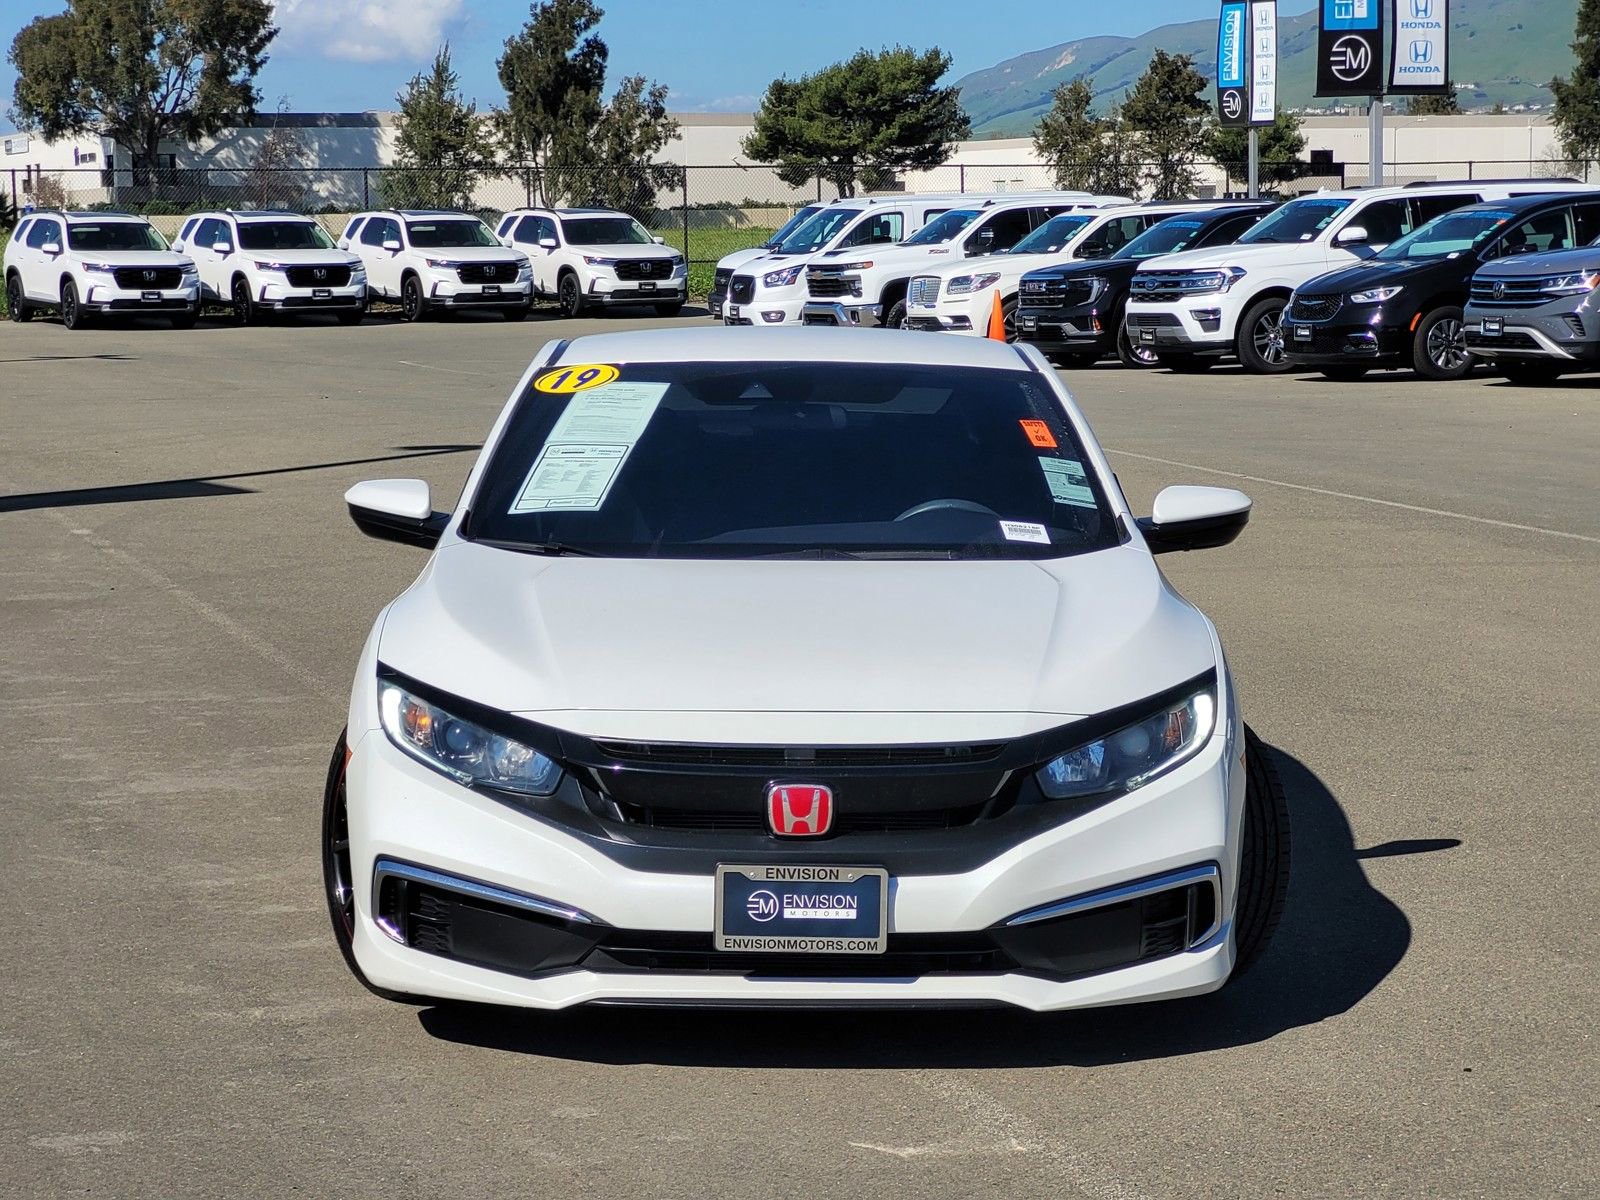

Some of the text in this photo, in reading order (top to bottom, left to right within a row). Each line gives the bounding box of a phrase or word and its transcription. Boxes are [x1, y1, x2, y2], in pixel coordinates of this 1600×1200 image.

[1223, 11, 1235, 80] ENVISION
[550, 368, 601, 390] 19
[765, 868, 839, 880] ENVISION
[783, 894, 857, 908] ENVISION
[724, 938, 878, 951] ENVISIONMOTORS.COM
